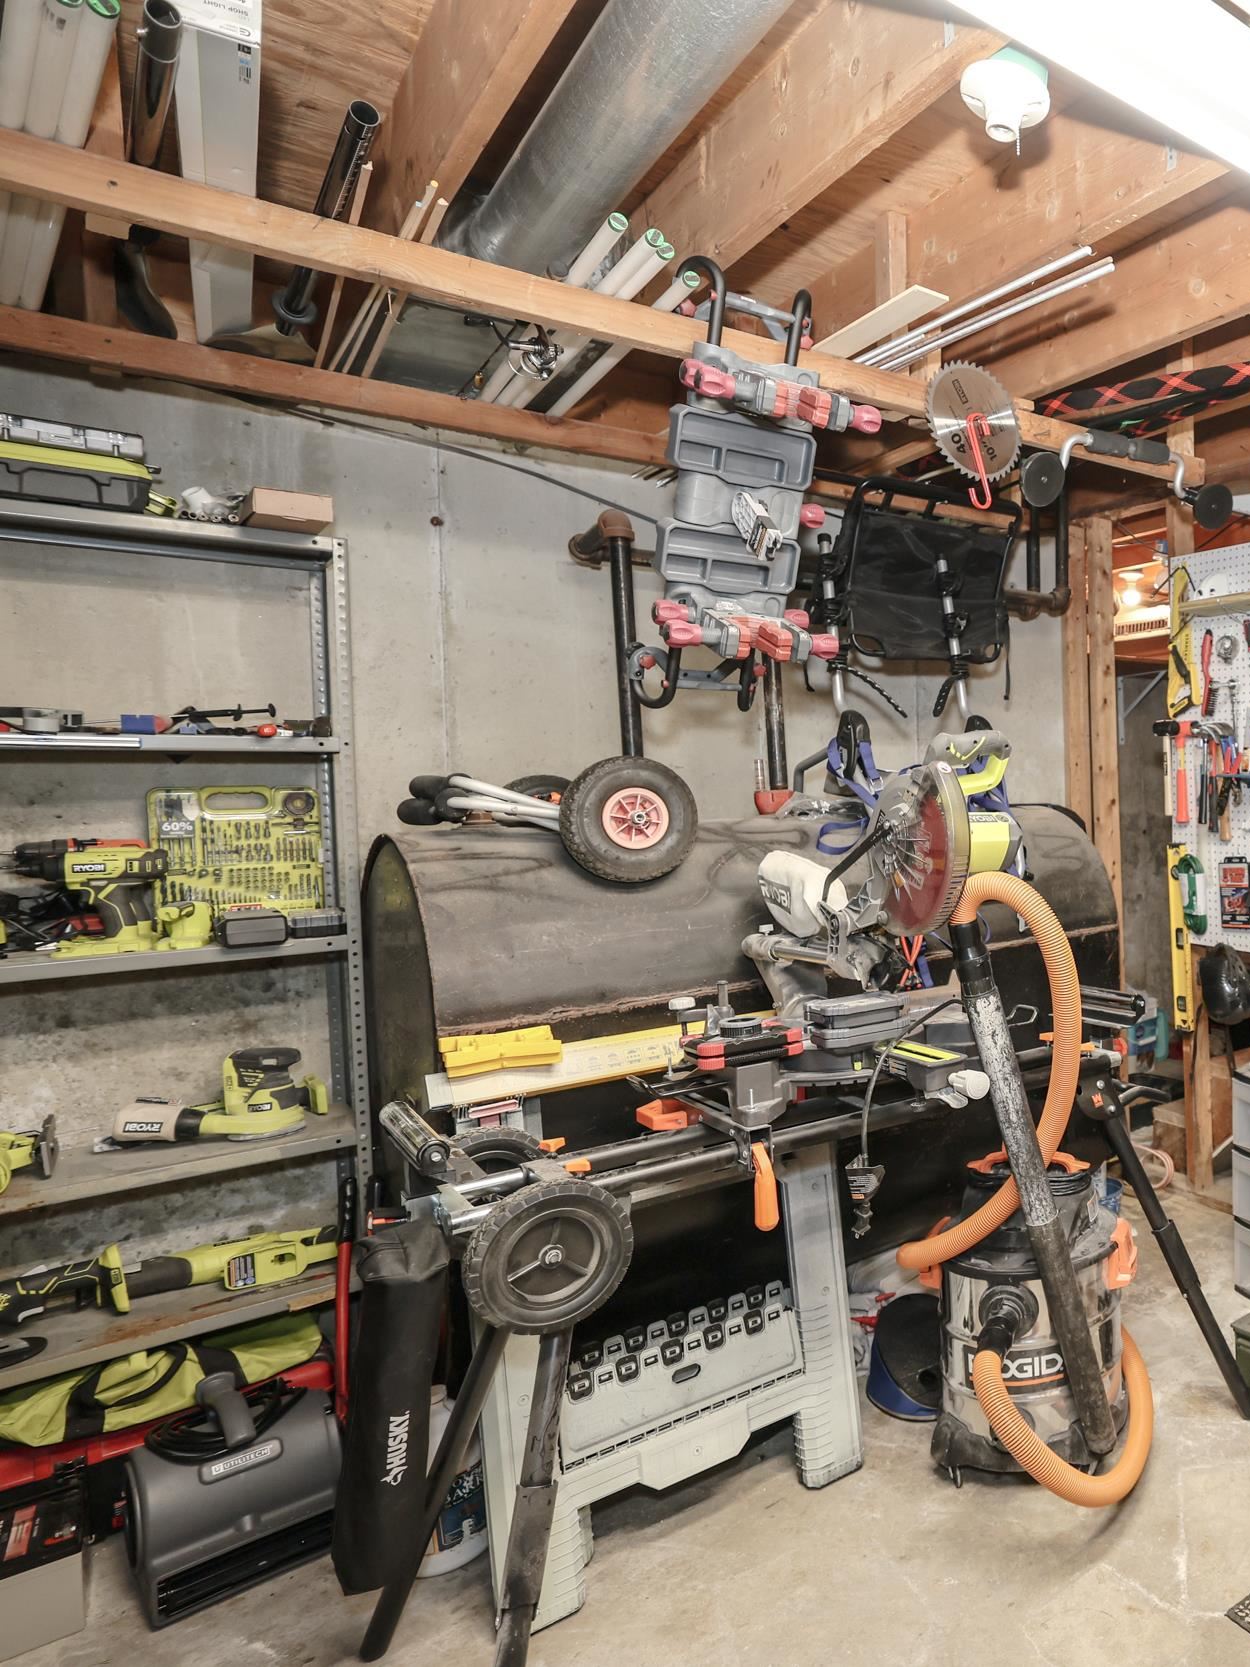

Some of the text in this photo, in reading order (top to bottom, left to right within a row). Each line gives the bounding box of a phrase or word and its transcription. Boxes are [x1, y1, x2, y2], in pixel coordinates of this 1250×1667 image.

[951, 433, 967, 454] 40
[161, 820, 193, 832] 60%
[73, 864, 105, 872] RYOBI
[759, 879, 791, 909] RYOBI
[125, 1123, 161, 1132] RYOBI
[223, 1447, 269, 1469] UTILITECH
